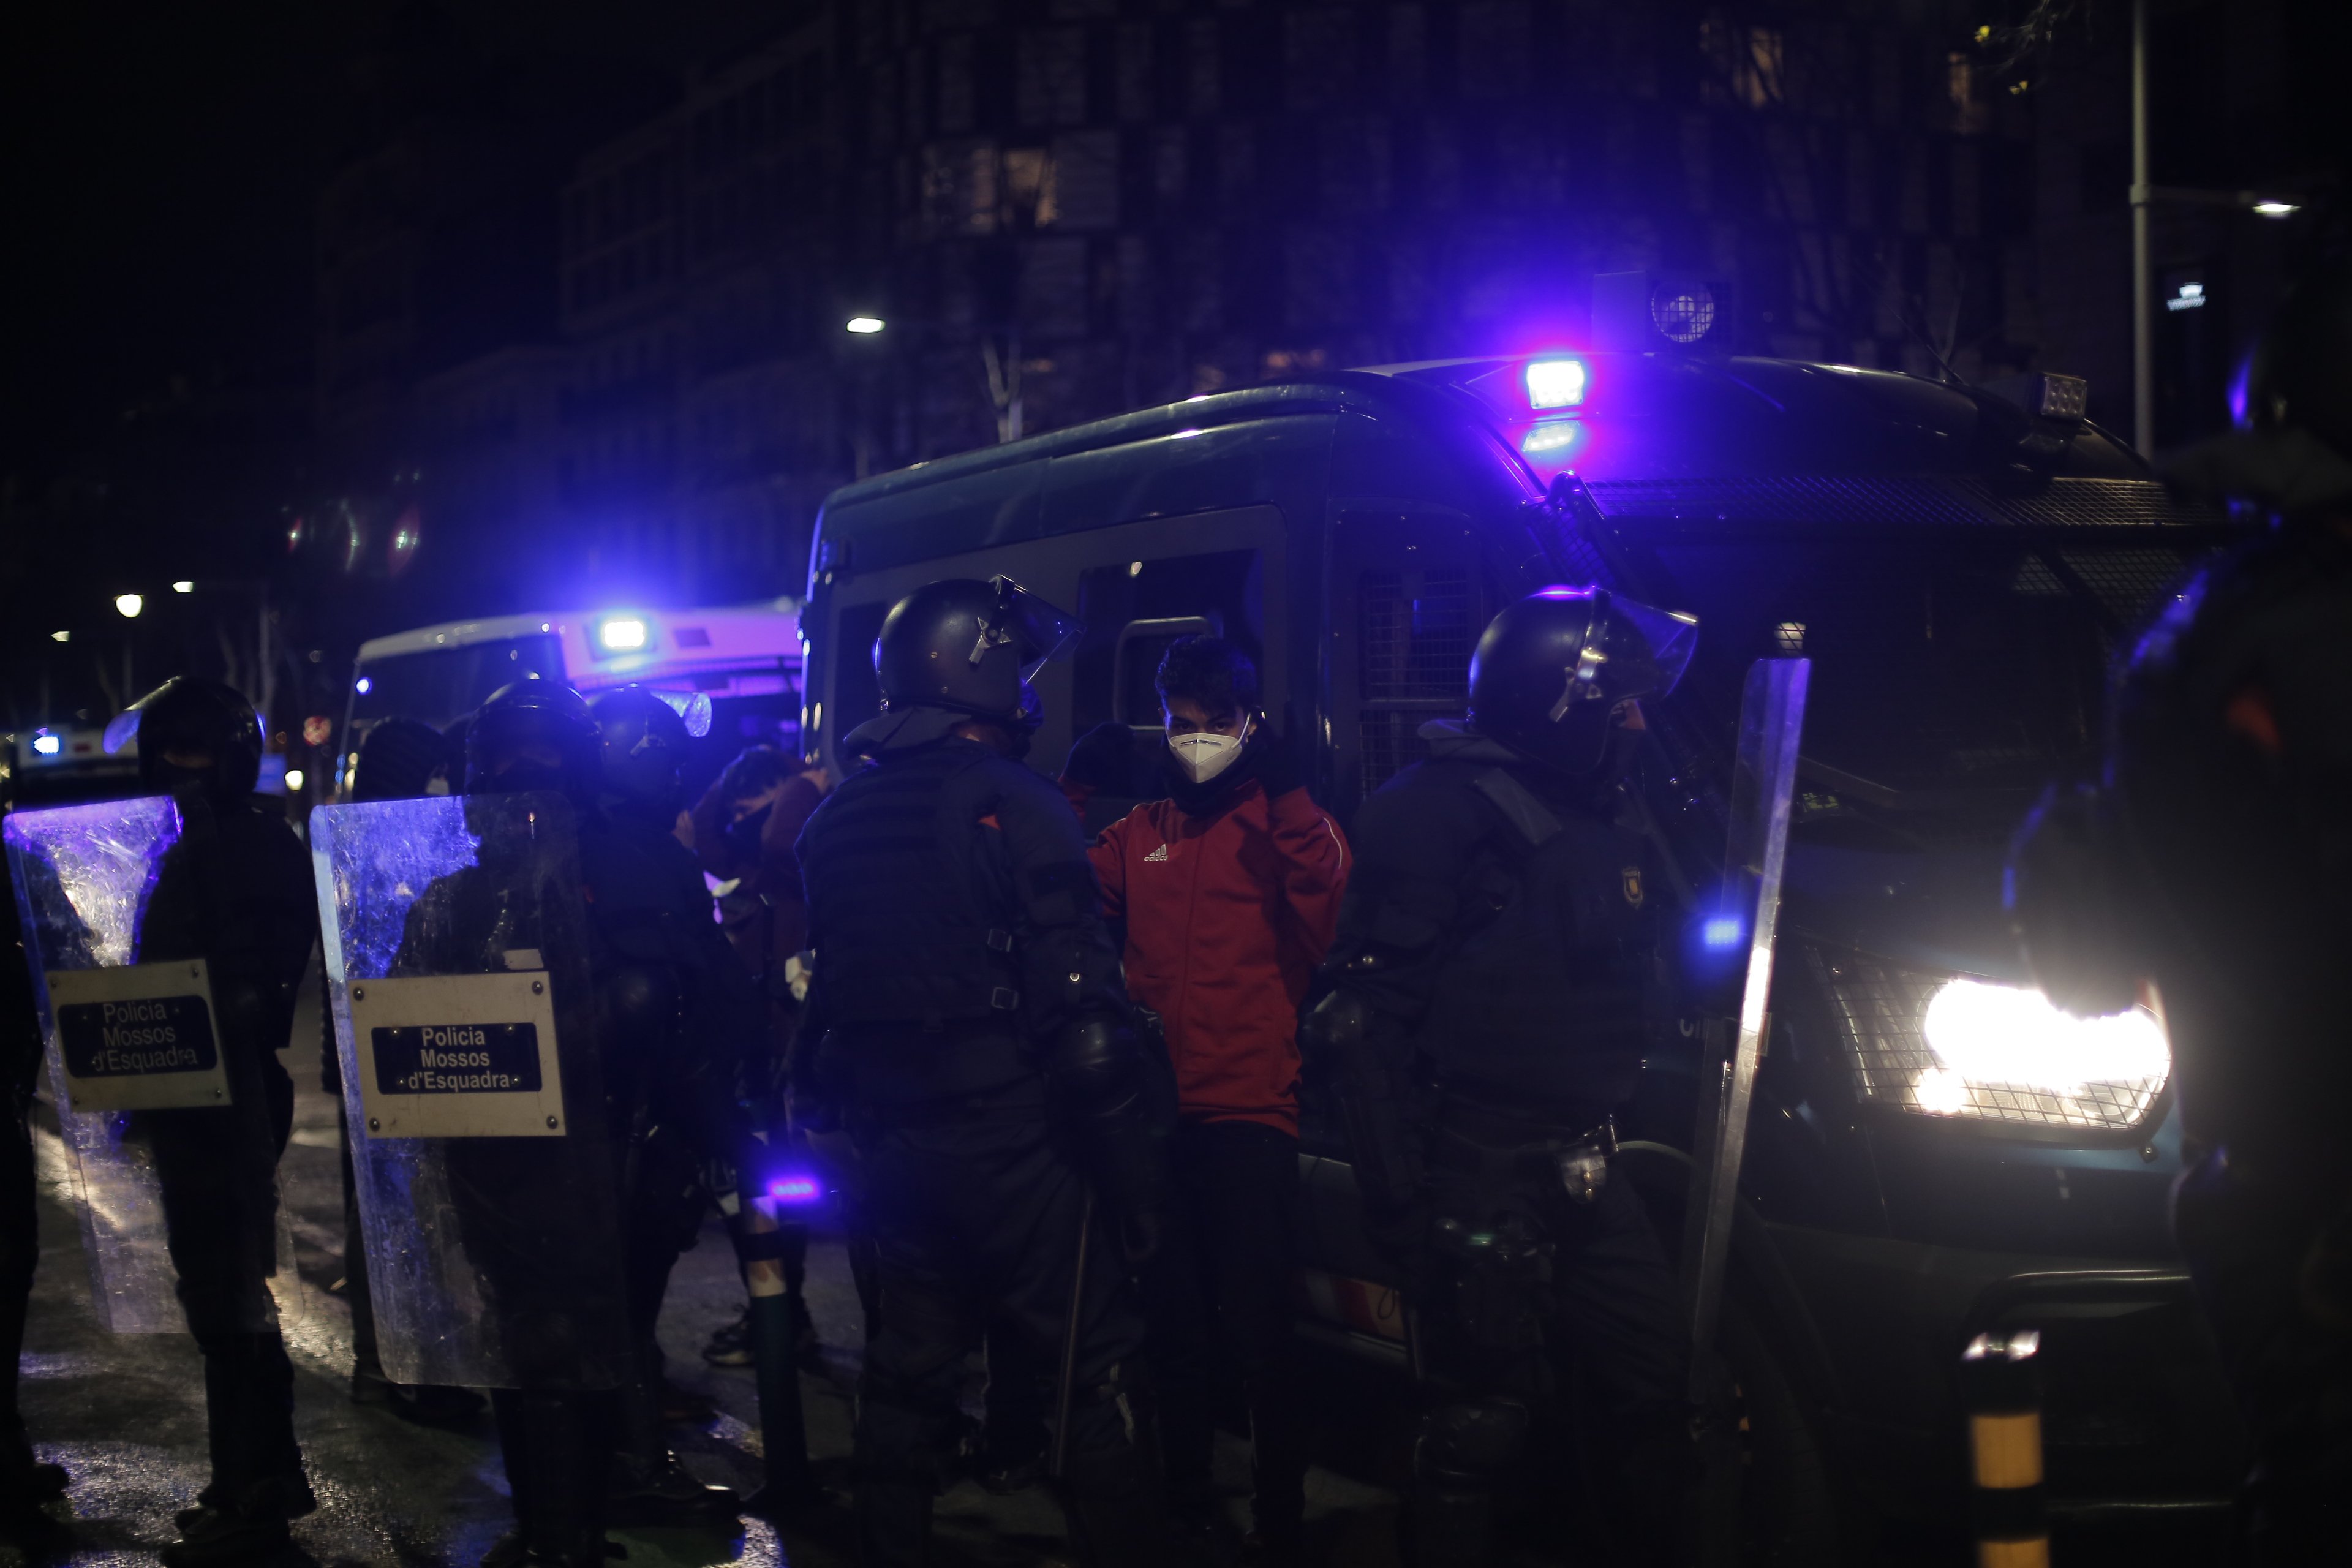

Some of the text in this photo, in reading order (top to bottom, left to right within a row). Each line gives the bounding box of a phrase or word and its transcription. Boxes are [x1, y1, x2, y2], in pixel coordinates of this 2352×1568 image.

[102, 1000, 167, 1024] Policia
[102, 1025, 176, 1047] Mossos
[421, 1026, 486, 1047] Policia
[92, 1046, 198, 1073] d'Esquadra
[420, 1049, 491, 1068] Mossos
[408, 1070, 510, 1093] d'Esquadra
